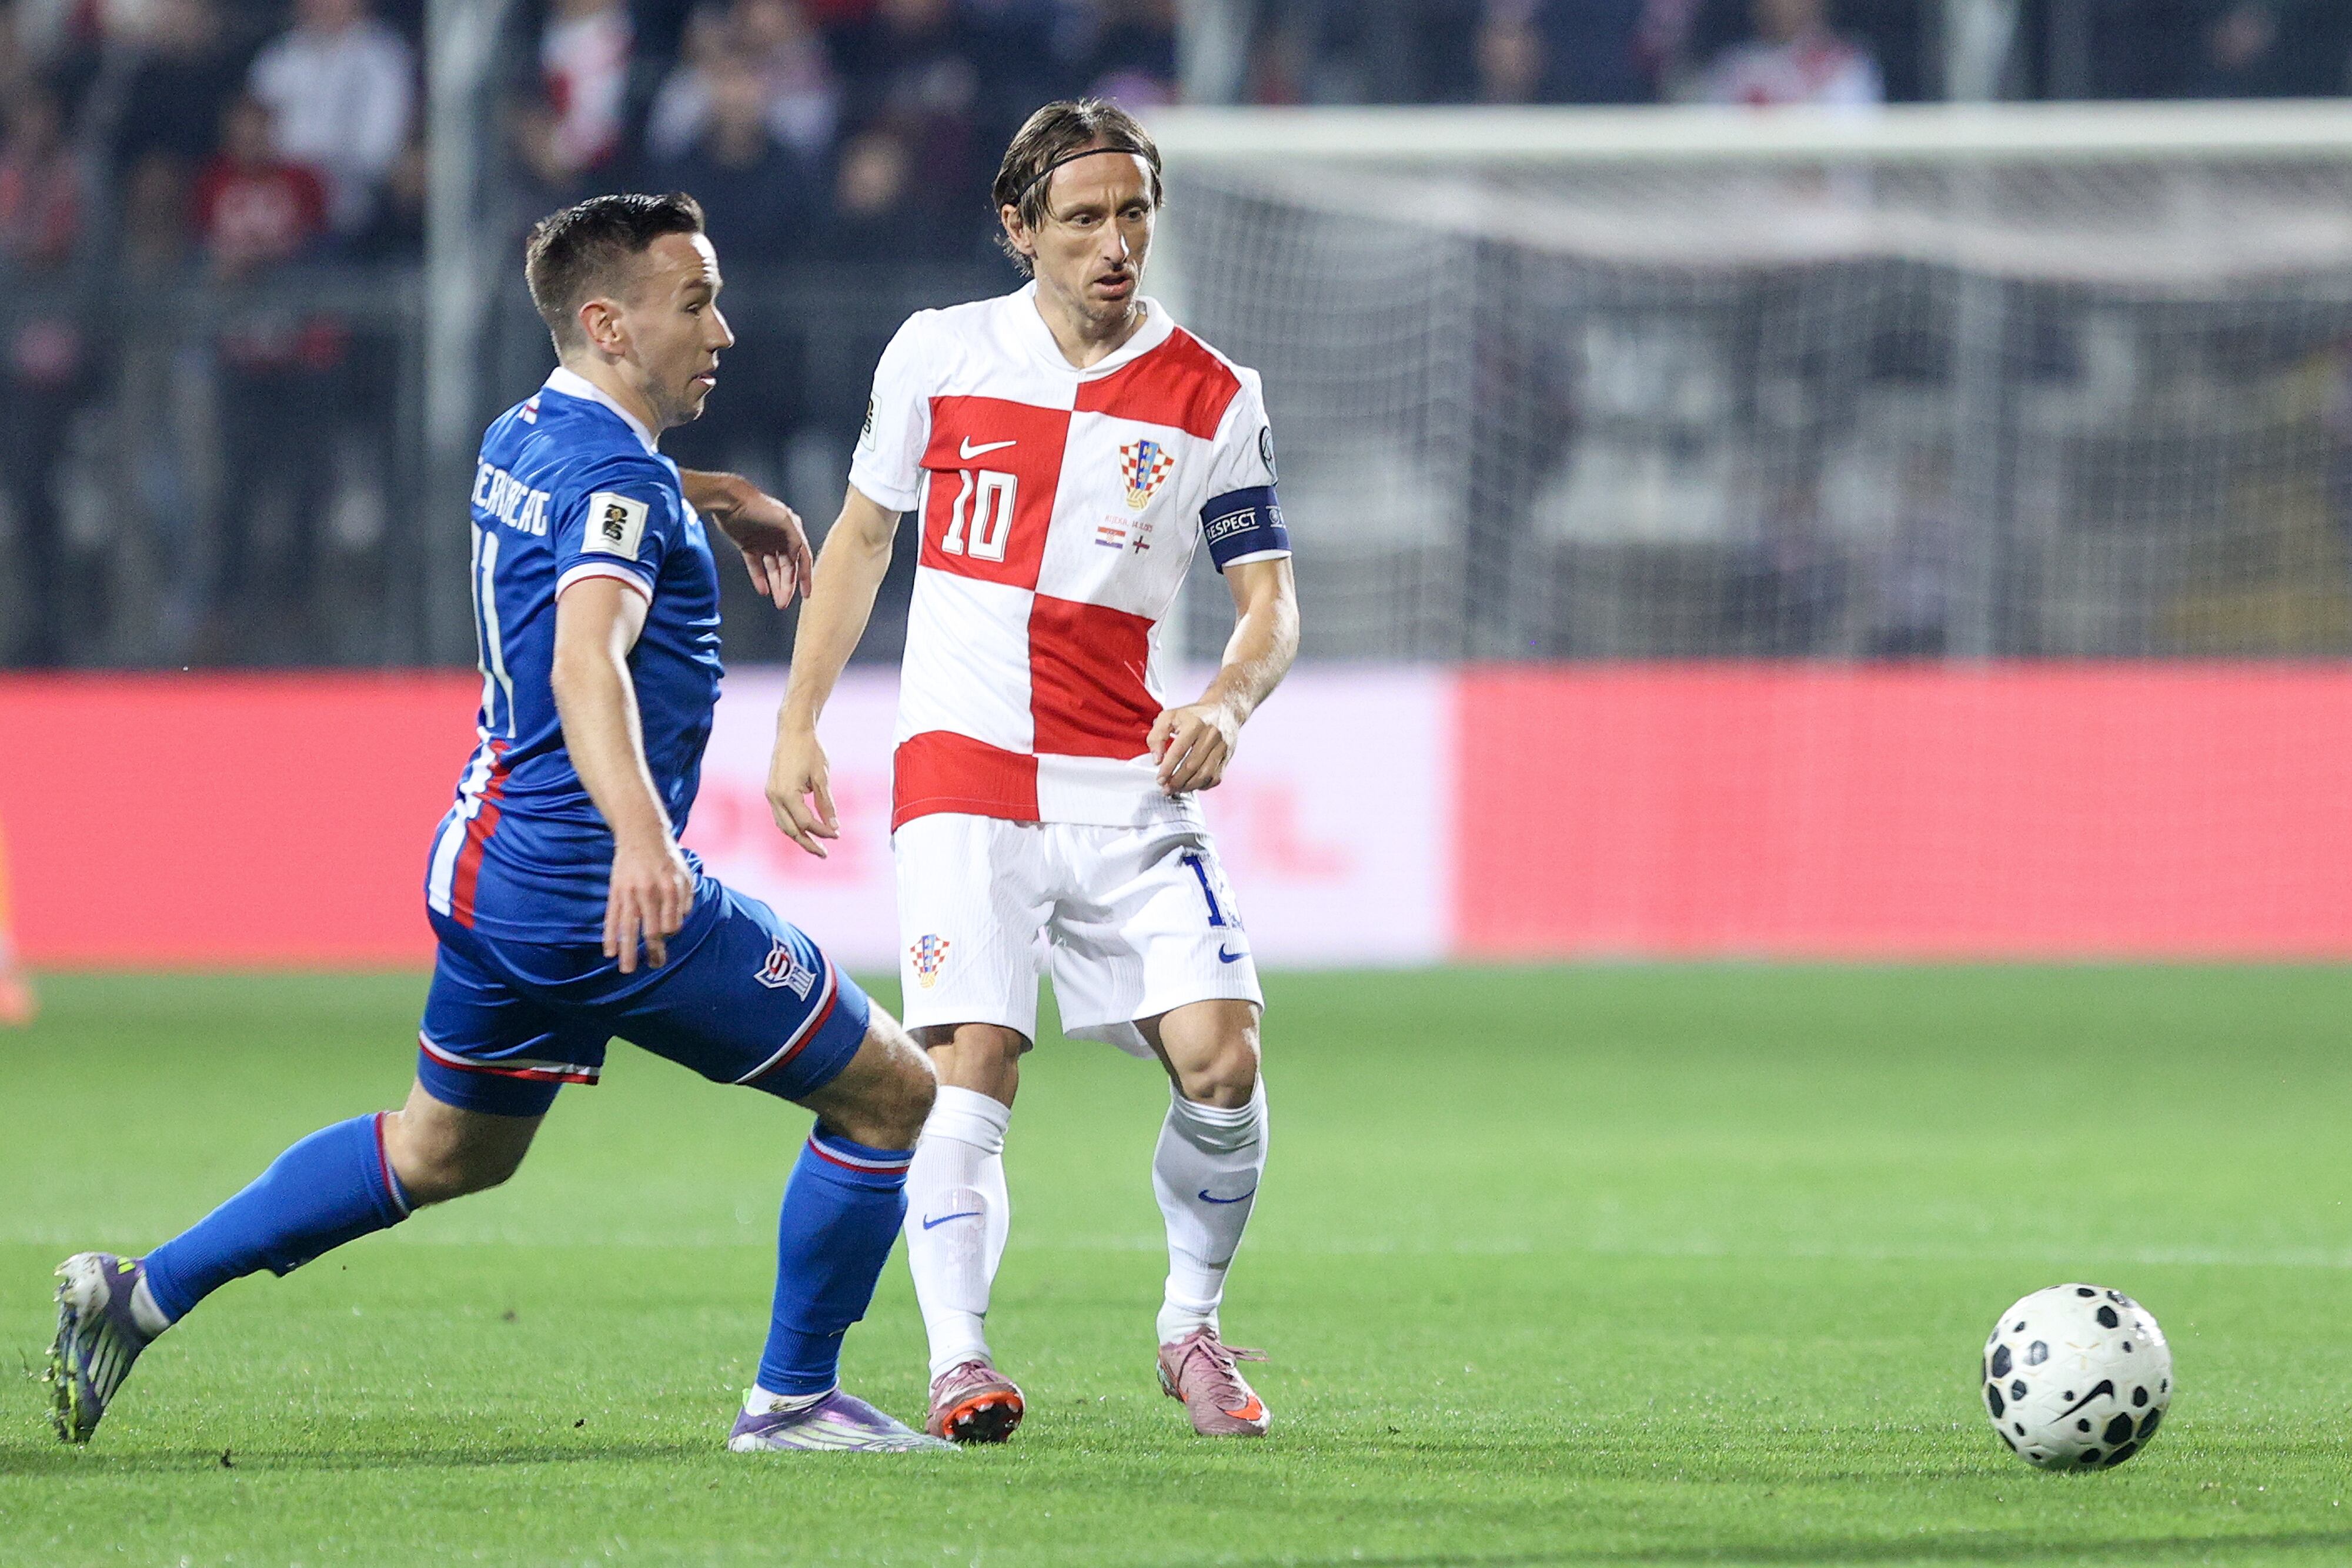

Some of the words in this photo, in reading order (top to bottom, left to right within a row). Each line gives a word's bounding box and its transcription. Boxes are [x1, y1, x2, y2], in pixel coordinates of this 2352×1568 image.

[941, 469, 1018, 563] 10
[1206, 512, 1256, 540] RESPECT
[470, 520, 516, 738] 11
